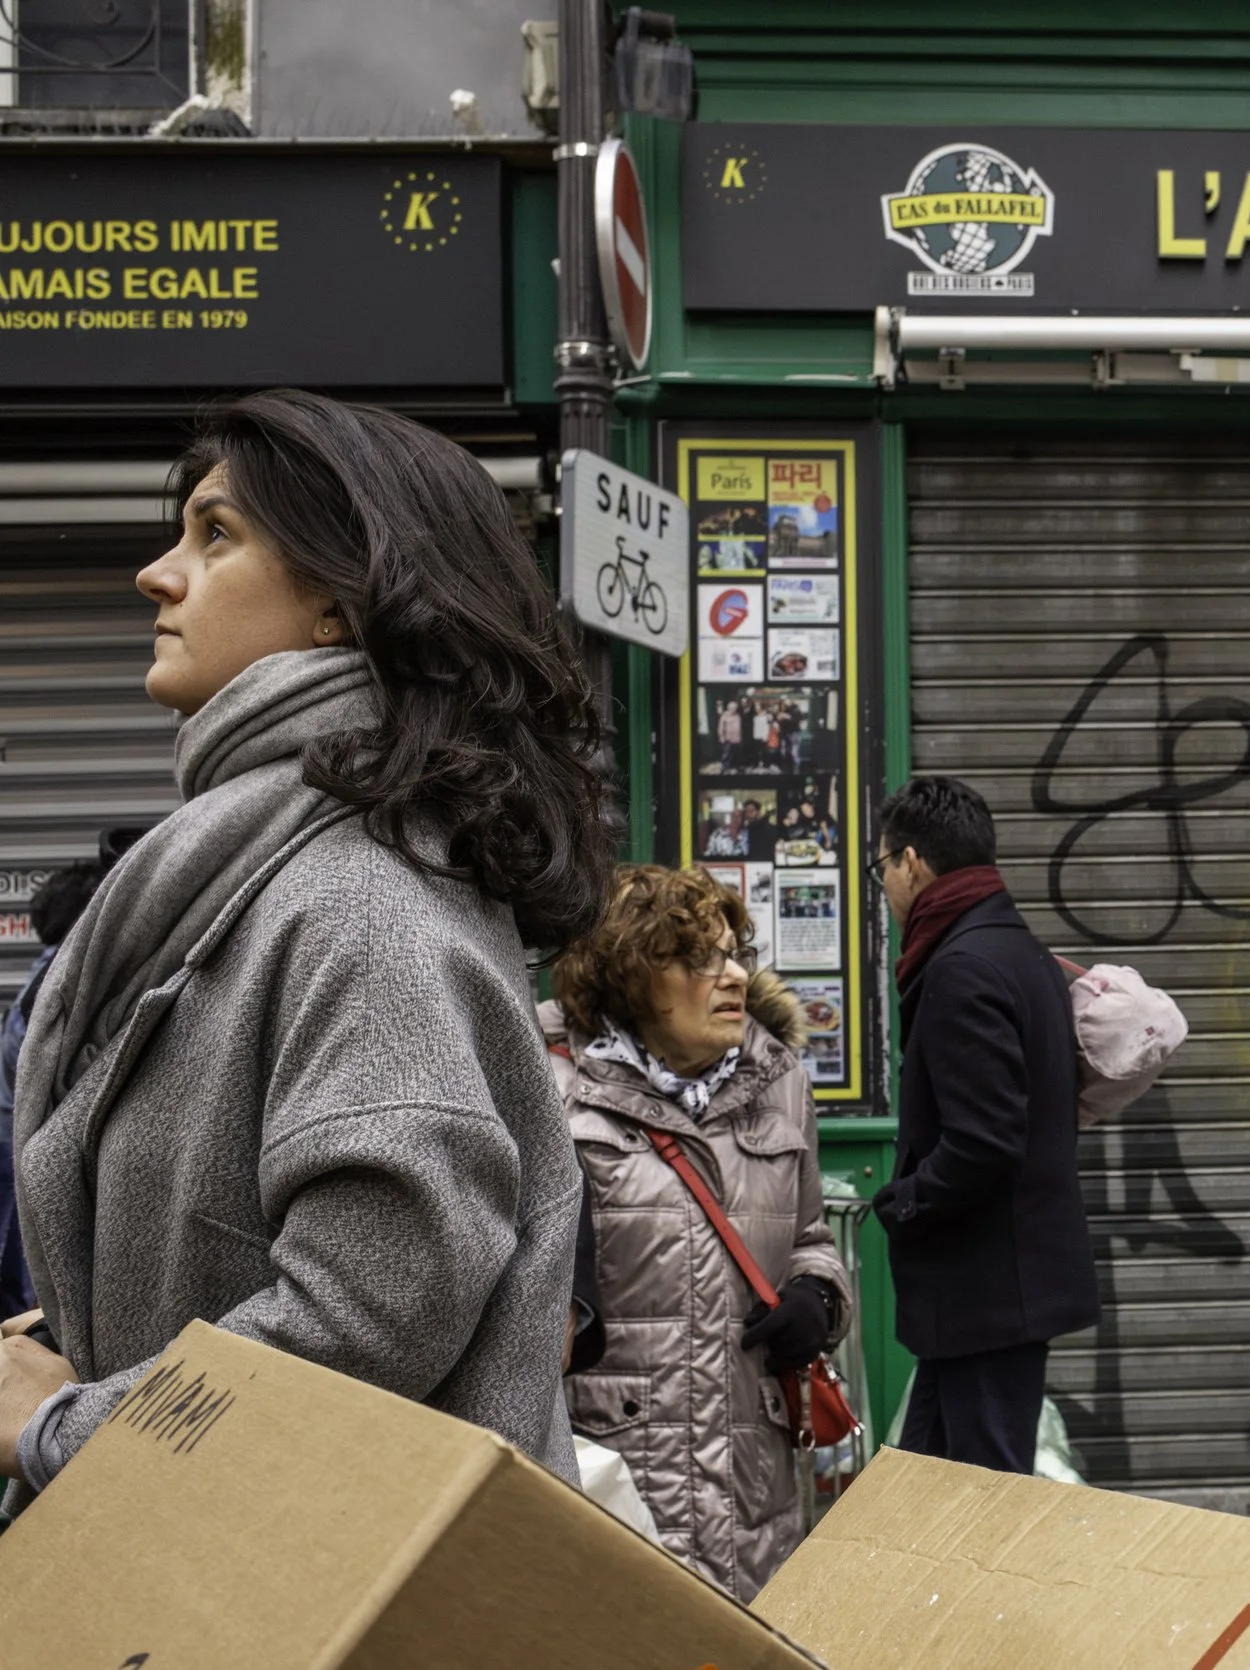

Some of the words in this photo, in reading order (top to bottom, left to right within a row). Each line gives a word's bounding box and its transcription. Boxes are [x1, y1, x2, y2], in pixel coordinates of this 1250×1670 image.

[404, 192, 438, 230] K
[955, 198, 1041, 218] FALLAFEL
[170, 219, 279, 251] IMITE
[123, 267, 258, 299] EGALE
[64, 309, 157, 329] FONDEE
[161, 310, 193, 329] EN
[200, 310, 248, 329] 1979
[771, 463, 823, 490] 파리
[597, 472, 671, 540] SAUF
